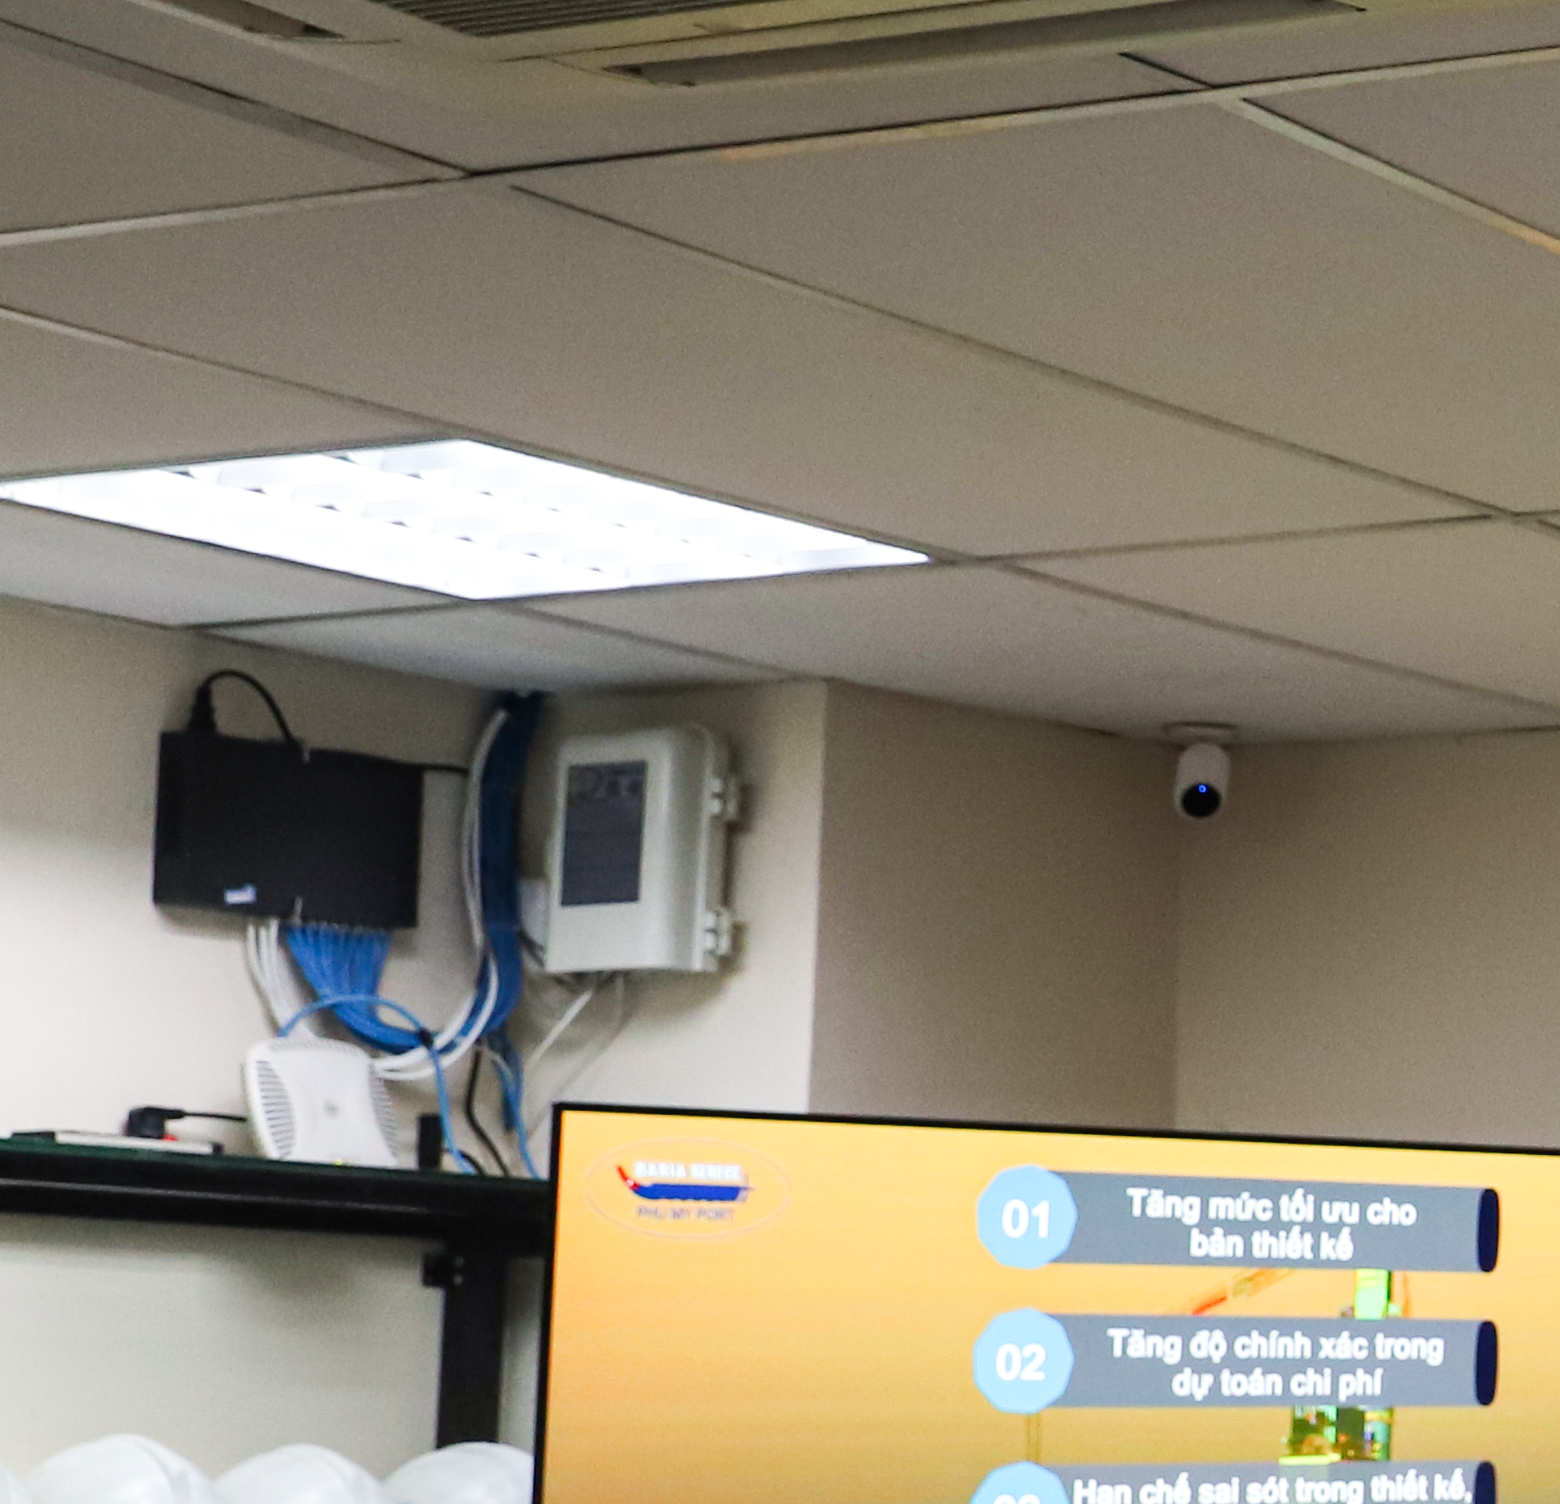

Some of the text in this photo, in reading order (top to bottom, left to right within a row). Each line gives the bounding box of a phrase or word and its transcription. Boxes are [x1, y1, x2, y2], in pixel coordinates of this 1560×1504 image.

[1001, 1198, 1050, 1239] 01
[1126, 1187, 1417, 1226] Tăng mức tối ưu cho
[1190, 1228, 1354, 1261] bản thiết kế
[995, 1344, 1046, 1381] 02
[1107, 1327, 1445, 1367] Tăng độ chính xác trong
[1172, 1368, 1383, 1402] dự toán chi phí
[1246, 1477, 1289, 1504] sót
[1370, 1469, 1427, 1502] thiết
